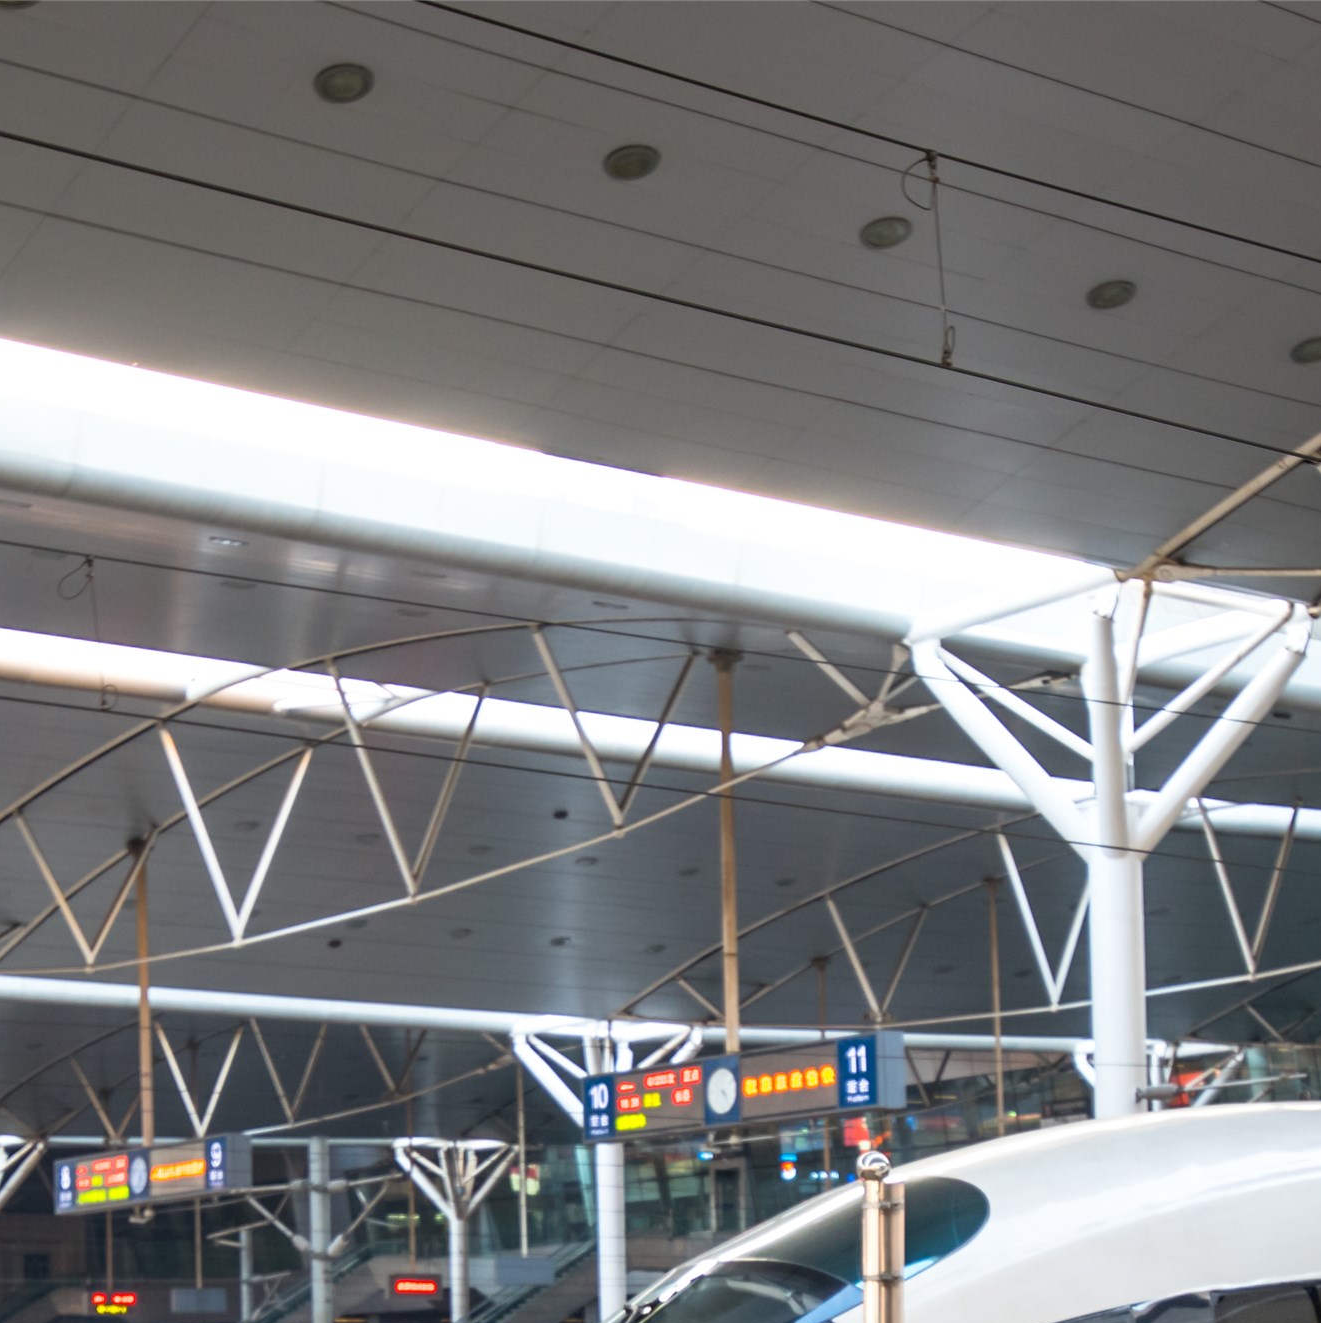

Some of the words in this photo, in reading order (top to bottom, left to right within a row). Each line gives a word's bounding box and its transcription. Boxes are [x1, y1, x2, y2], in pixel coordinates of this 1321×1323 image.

[845, 1044, 868, 1075] 11
[588, 1082, 610, 1110] 10
[210, 1141, 223, 1168] 9
